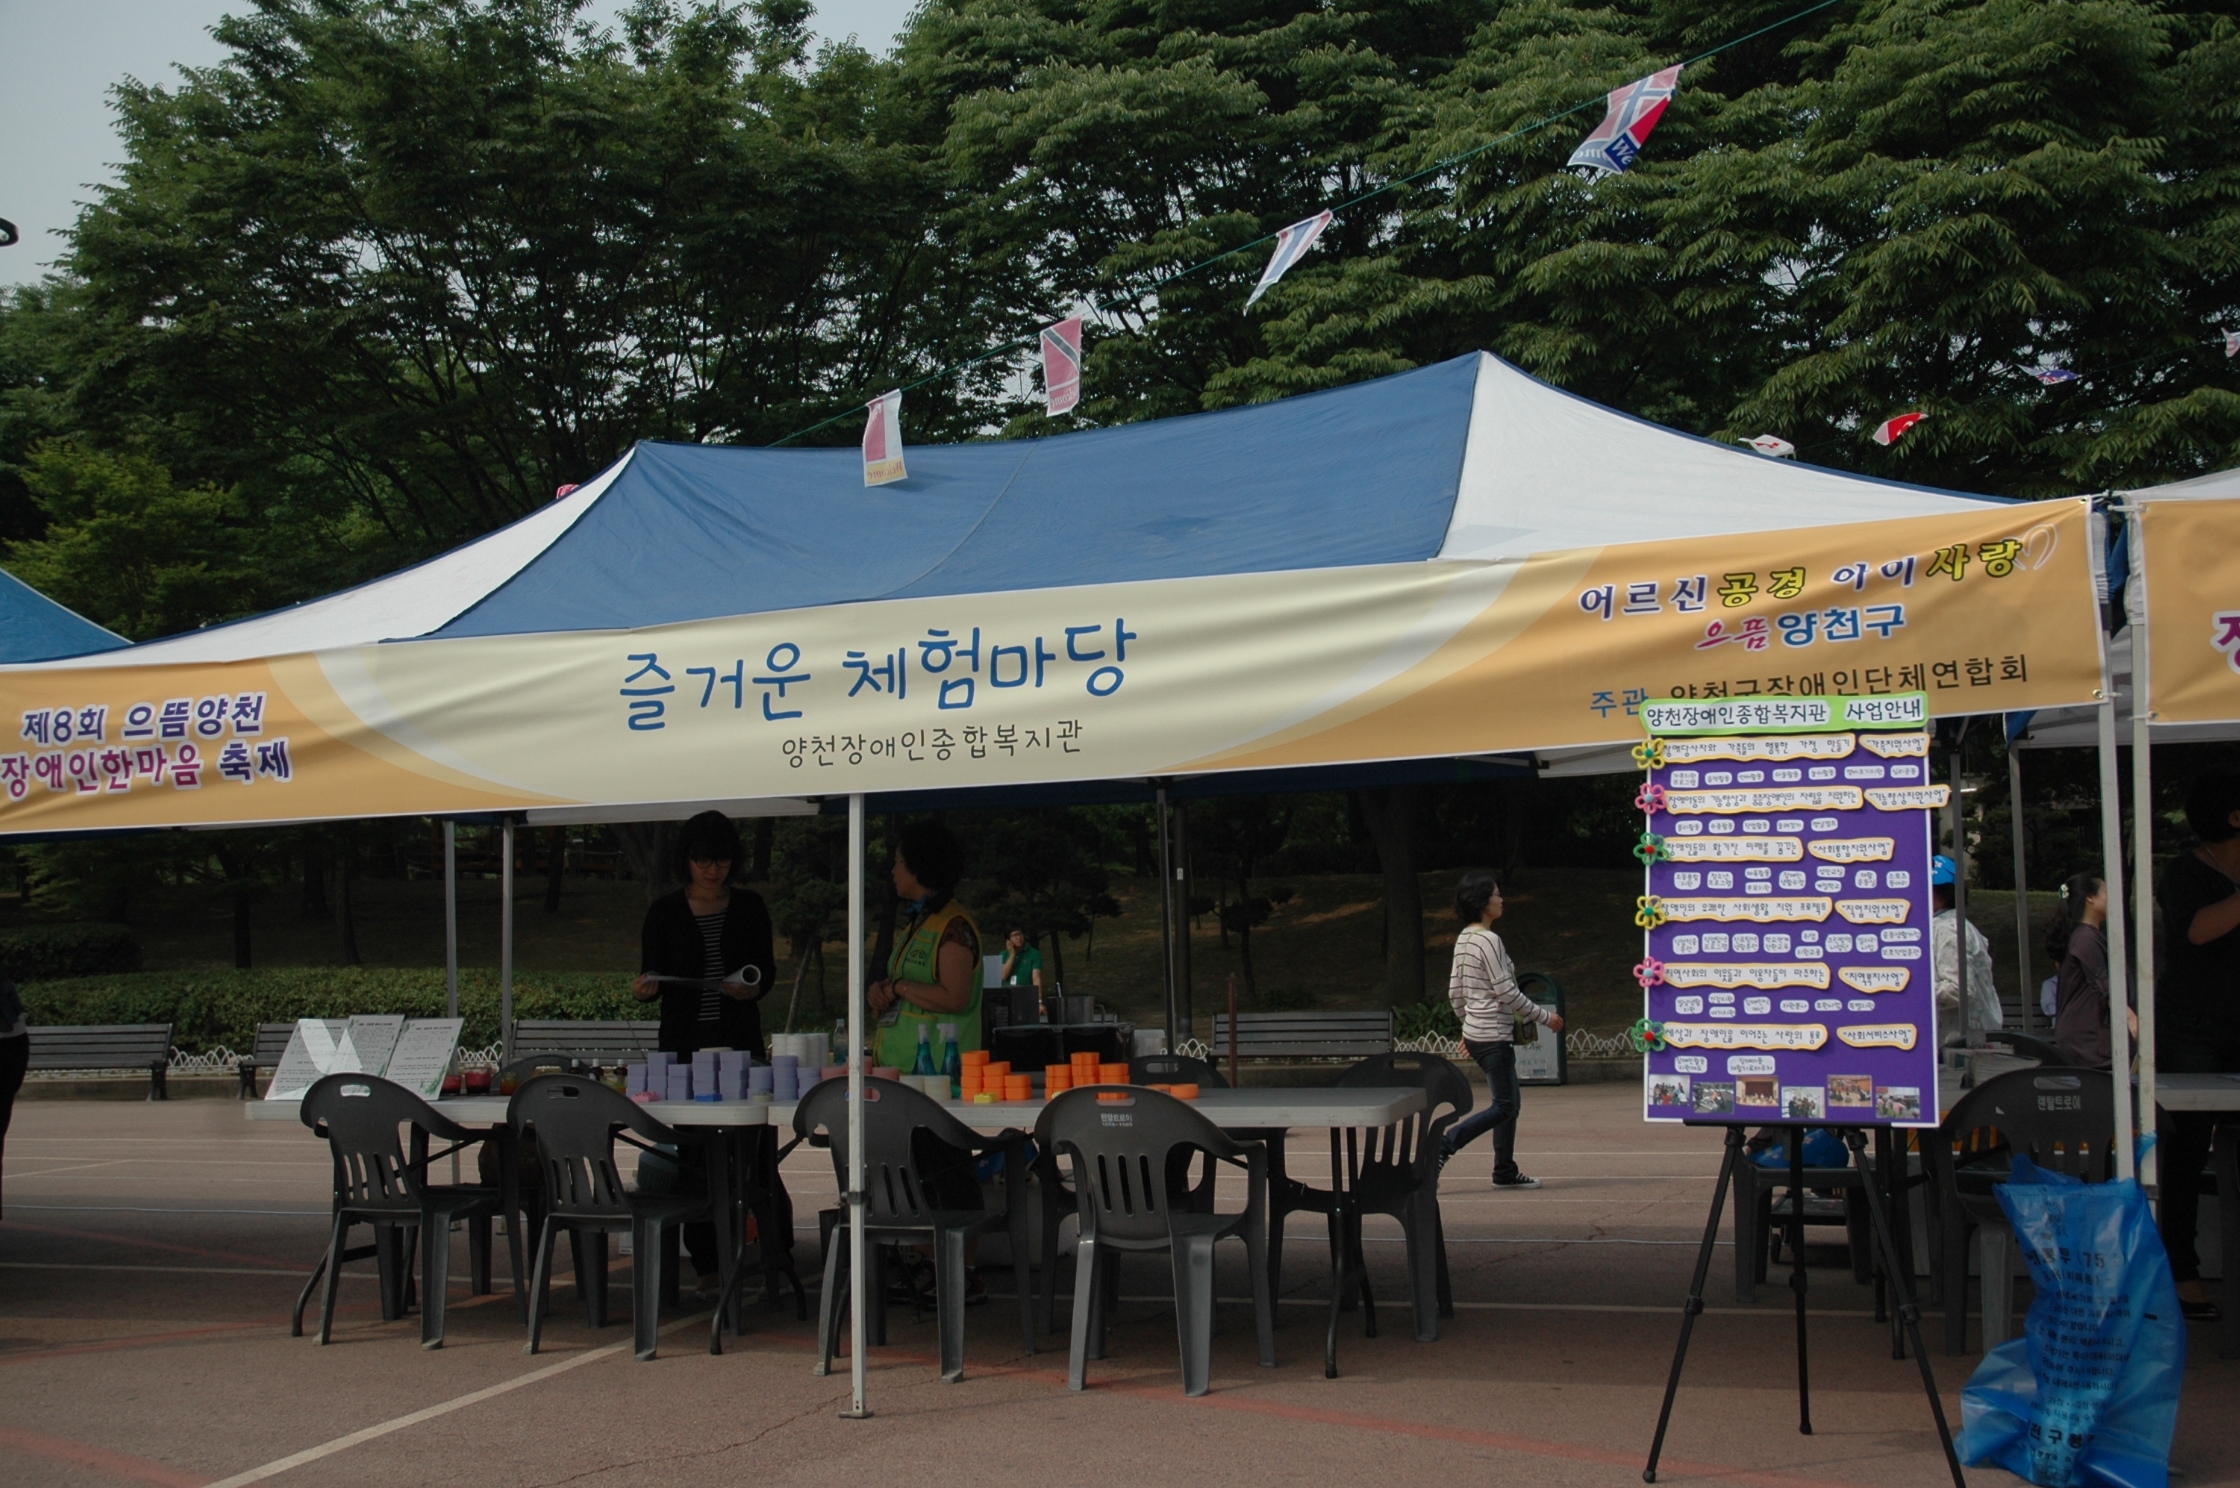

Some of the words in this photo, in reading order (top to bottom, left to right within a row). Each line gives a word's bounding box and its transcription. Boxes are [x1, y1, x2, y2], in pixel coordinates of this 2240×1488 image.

[619, 642, 812, 732] 즐거운
[842, 618, 1137, 711] 체험마당
[1589, 687, 1649, 718] 주관
[21, 708, 105, 744] 제8회
[124, 691, 267, 739] 으뜸양천
[1647, 704, 1827, 727] 양천장애인종합복지관
[1846, 698, 1921, 721] 사업안내
[782, 719, 1084, 769] 양천장애인종합복지관
[1765, 741, 1789, 755] 행복한
[1799, 740, 1818, 753] 가정
[1826, 739, 1850, 753] 만들기
[0, 742, 203, 802] 장애인한마음
[218, 737, 291, 783] 축제
[1800, 792, 1822, 805] 자립을
[1827, 790, 1857, 805] 지원하는
[1745, 842, 1769, 855] 미래를
[1733, 902, 1769, 916] 사회생활
[1776, 902, 1793, 916] 지원
[1800, 902, 1827, 916] 프로젝트
[1665, 968, 1707, 982] 지역사회의
[1749, 968, 1787, 982] 이용자들이
[1700, 1029, 1733, 1043] 장애인을
[1775, 1029, 1803, 1045] 사랑의
[2037, 1095, 2081, 1111] 렌탈트로이
